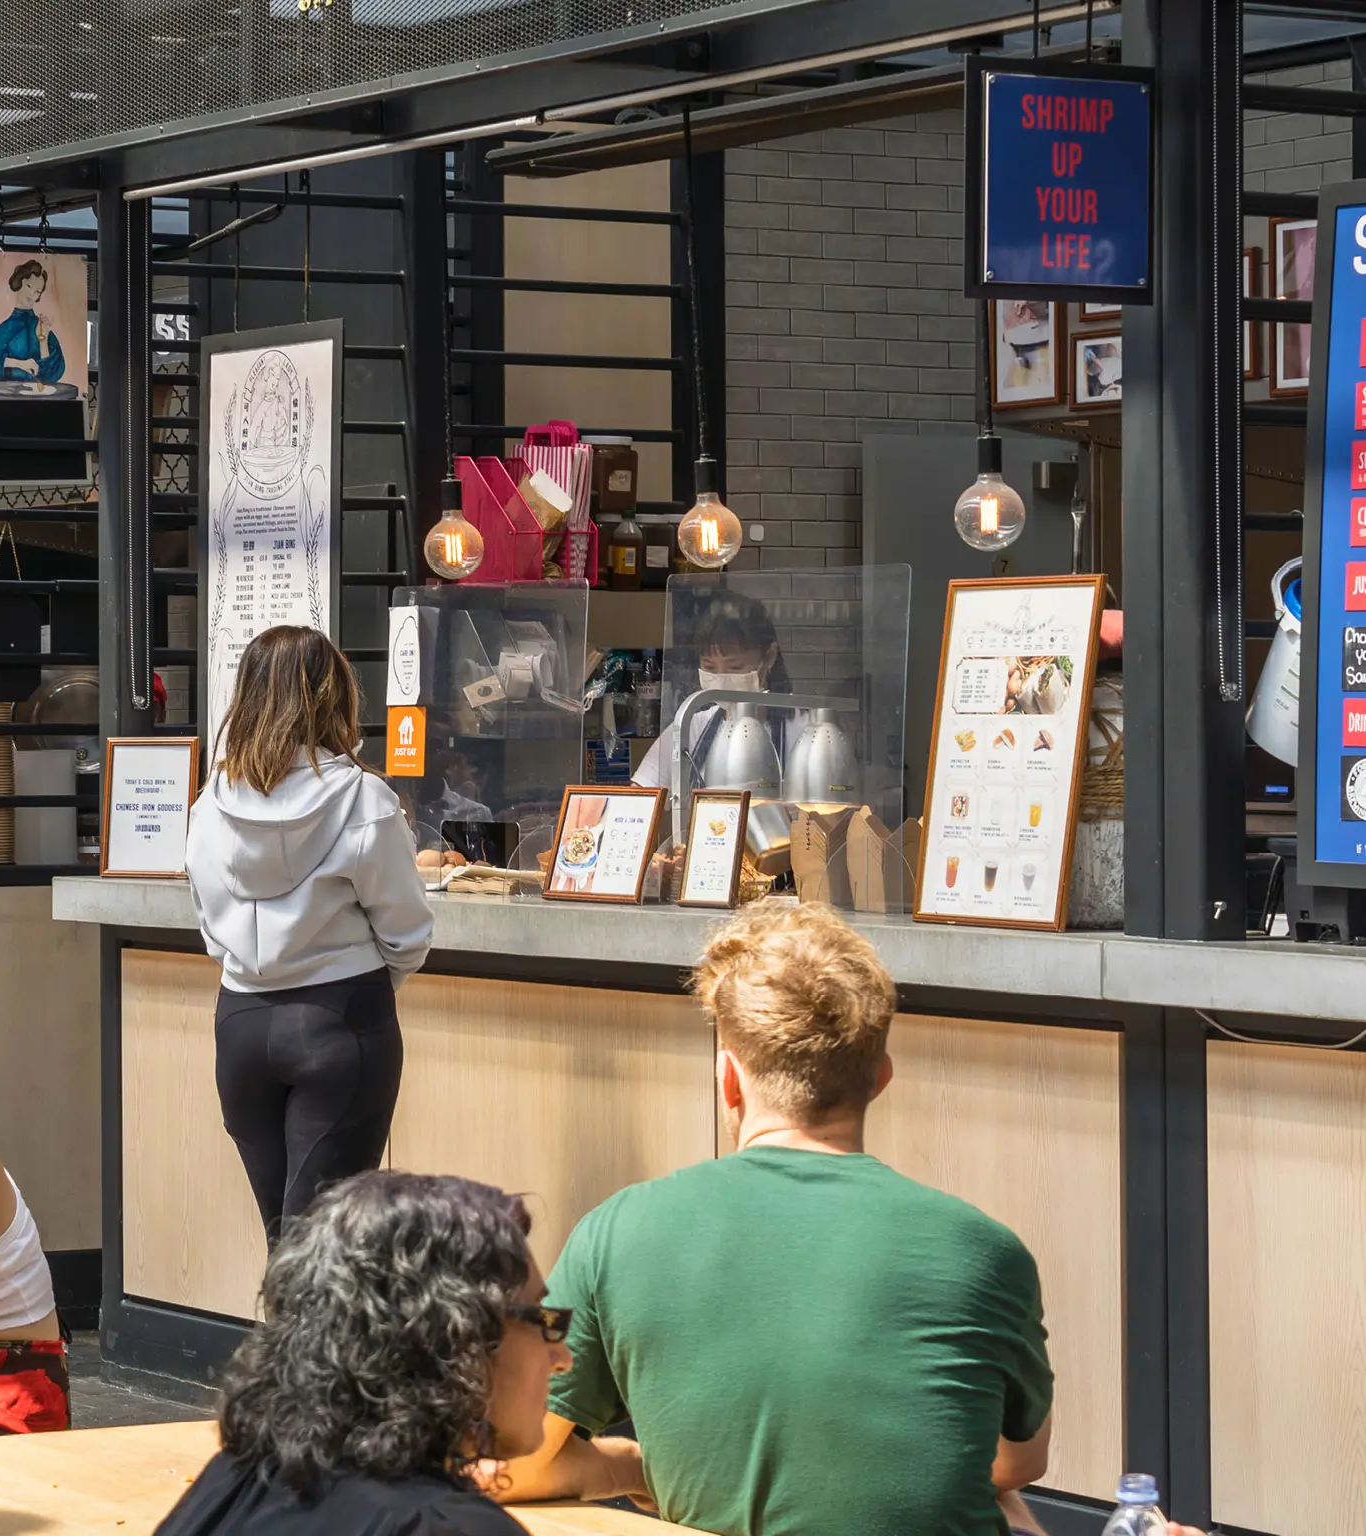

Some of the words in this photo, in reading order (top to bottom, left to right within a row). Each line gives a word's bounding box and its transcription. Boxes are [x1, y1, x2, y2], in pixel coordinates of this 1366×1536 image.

[1021, 94, 1113, 134] SHRIMP
[1052, 142, 1083, 177] UP
[1036, 187, 1098, 224] YOUR
[1042, 232, 1091, 269] LIFE
[1000, 558, 1008, 574] 7
[394, 747, 406, 757] JUST
[407, 747, 417, 756] EAT
[115, 803, 139, 811] CHINESE
[142, 803, 155, 811] IRON
[157, 803, 183, 812] GODDESS
